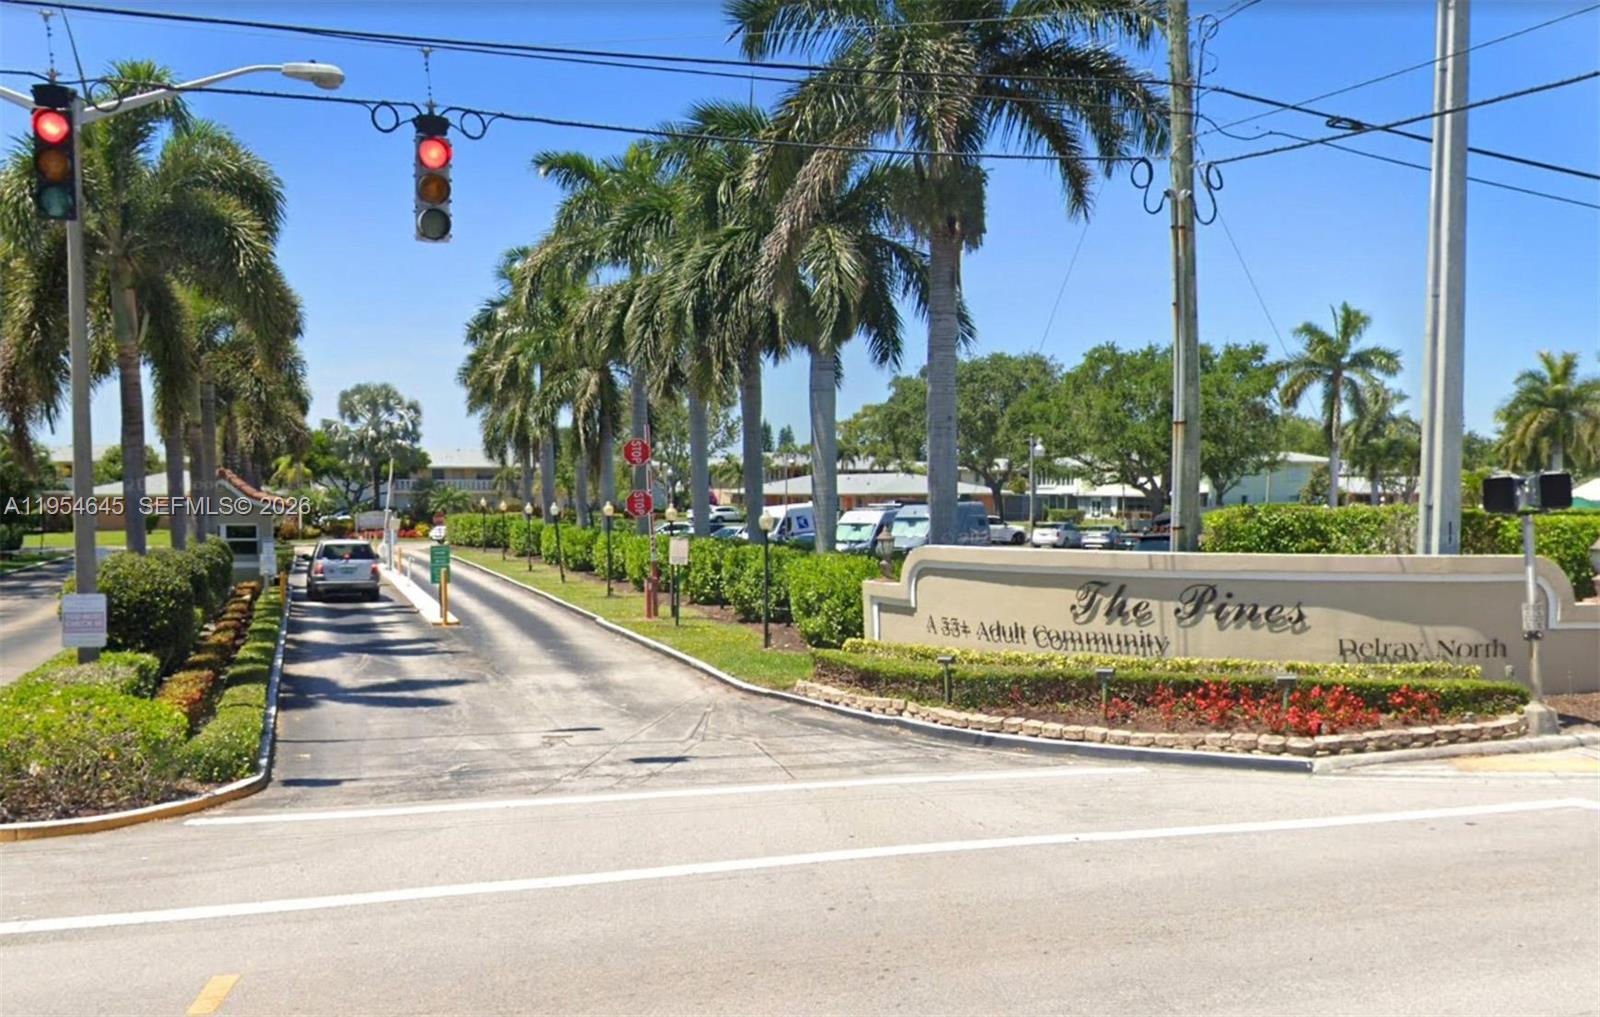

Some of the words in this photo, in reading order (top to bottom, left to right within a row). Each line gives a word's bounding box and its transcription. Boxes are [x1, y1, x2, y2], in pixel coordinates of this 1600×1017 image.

[631, 440, 642, 464] STOP
[634, 492, 645, 515] STOP
[1070, 581, 1150, 623] The
[1174, 583, 1306, 626] Pines
[926, 614, 938, 635] A
[976, 619, 1027, 645] Adult
[1032, 624, 1170, 657] Community
[1338, 637, 1424, 659] Delray
[1436, 637, 1508, 659] North
